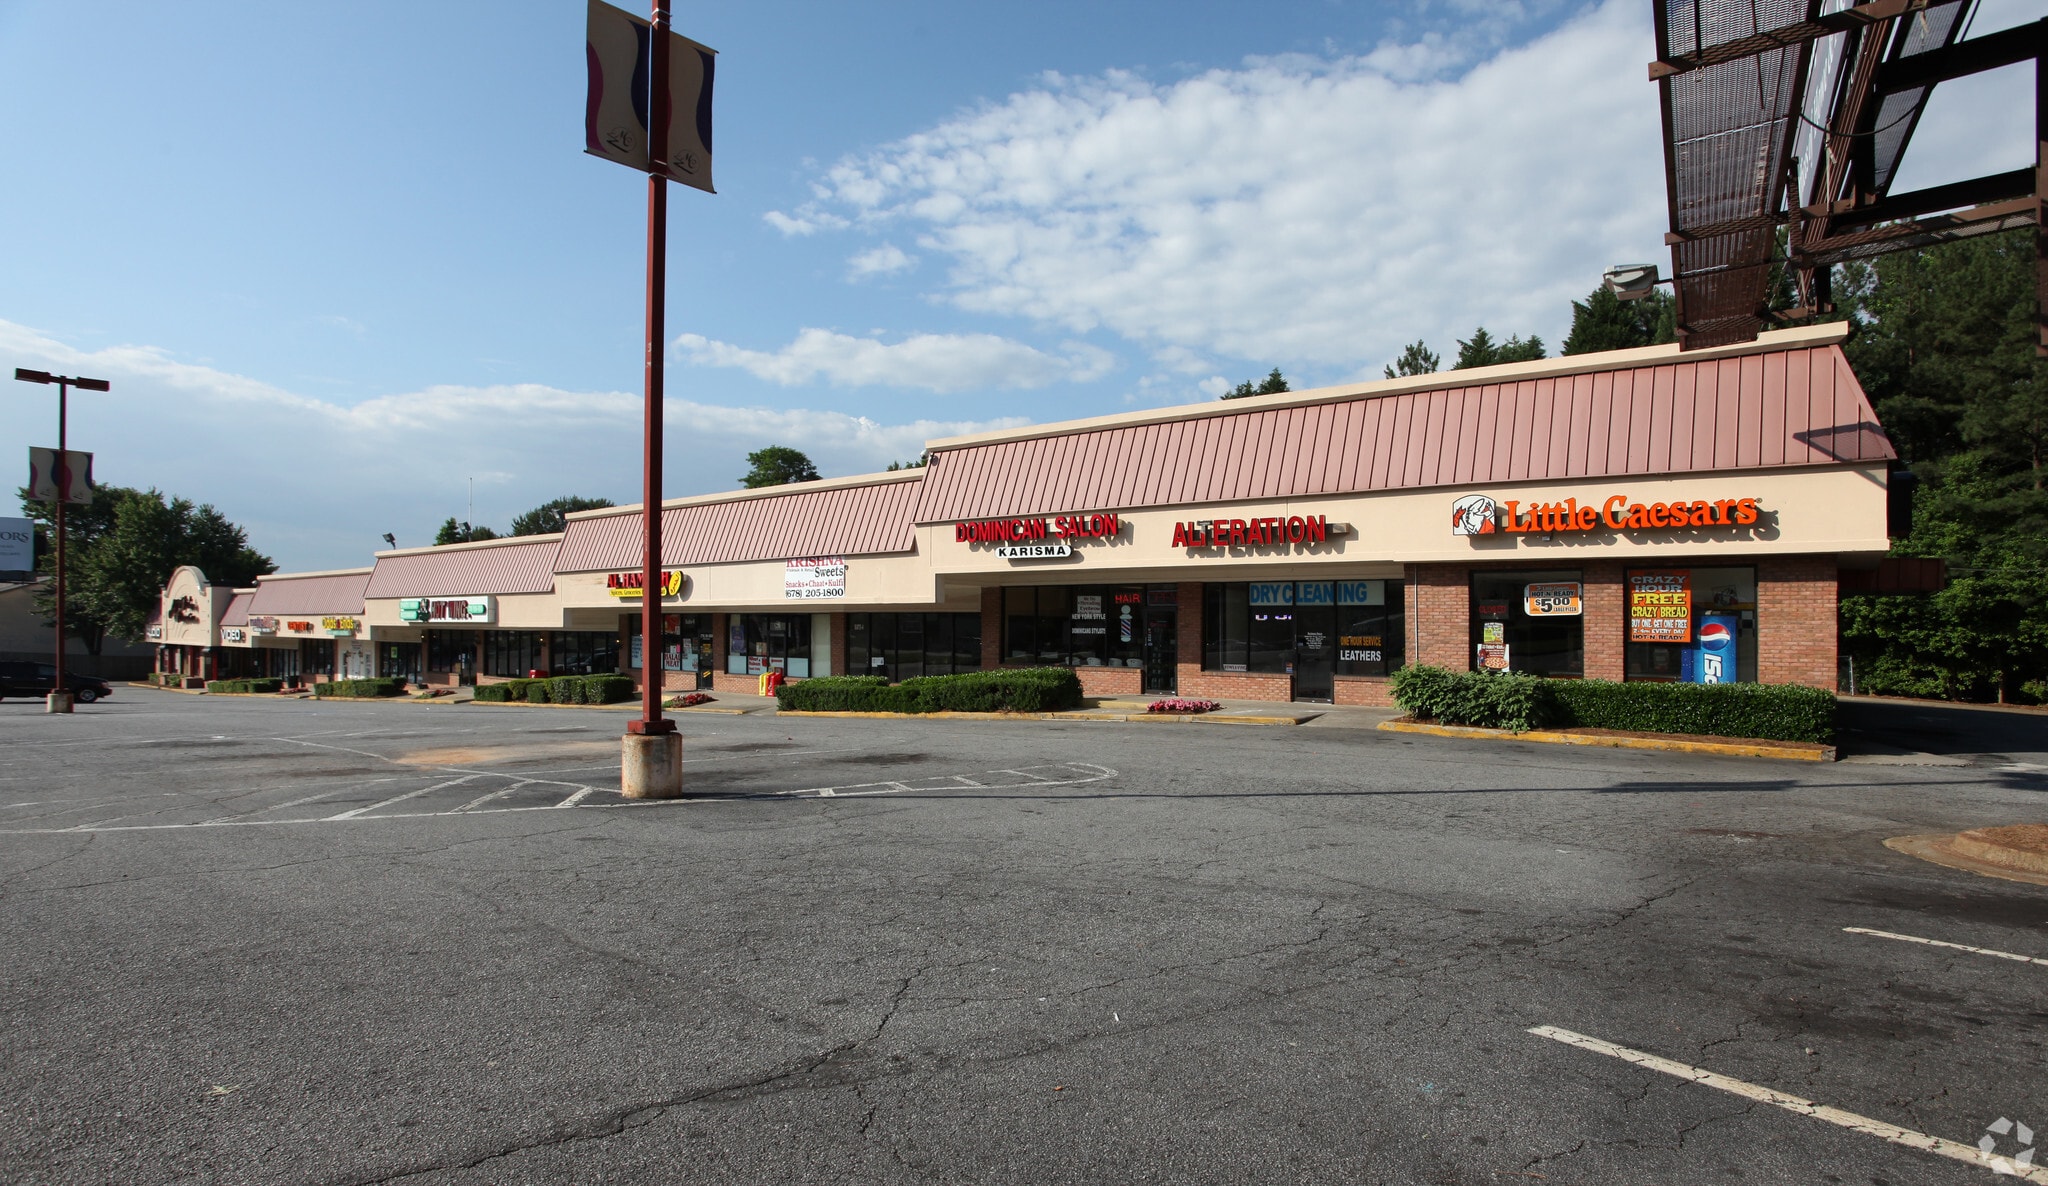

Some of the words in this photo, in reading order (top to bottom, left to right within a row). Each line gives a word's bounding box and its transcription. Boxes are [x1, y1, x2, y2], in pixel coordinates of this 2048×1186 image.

[1504, 498, 1596, 533] Little
[1602, 495, 1757, 529] Caesars
[956, 518, 1047, 543] DOMINICAN
[1054, 513, 1119, 540] SALON
[1172, 515, 1326, 548] ALTERATION
[998, 546, 1067, 557] KARISMA
[786, 556, 845, 568] KRISHNA
[814, 566, 844, 578] Sweets
[785, 580, 805, 589] Snacks
[809, 580, 825, 588] Chaat
[828, 578, 844, 588] Kulfi
[1631, 576, 1686, 584] CRAZY
[785, 590, 803, 598] (678)
[806, 588, 844, 598] 205-1800
[1250, 584, 1281, 604] DRY
[1635, 584, 1683, 592] HOUR
[1115, 593, 1141, 604] HAIR
[1633, 593, 1686, 605] FREE
[1631, 606, 1659, 618] CRAZY
[1660, 606, 1688, 618] BREAD
[220, 629, 242, 641] VIDEO
[1340, 635, 1350, 647] ONE
[1350, 635, 1362, 647] HOUR
[1363, 635, 1382, 647] SERVICE
[1340, 650, 1382, 662] LEATHERS
[665, 660, 680, 668] MEAT
